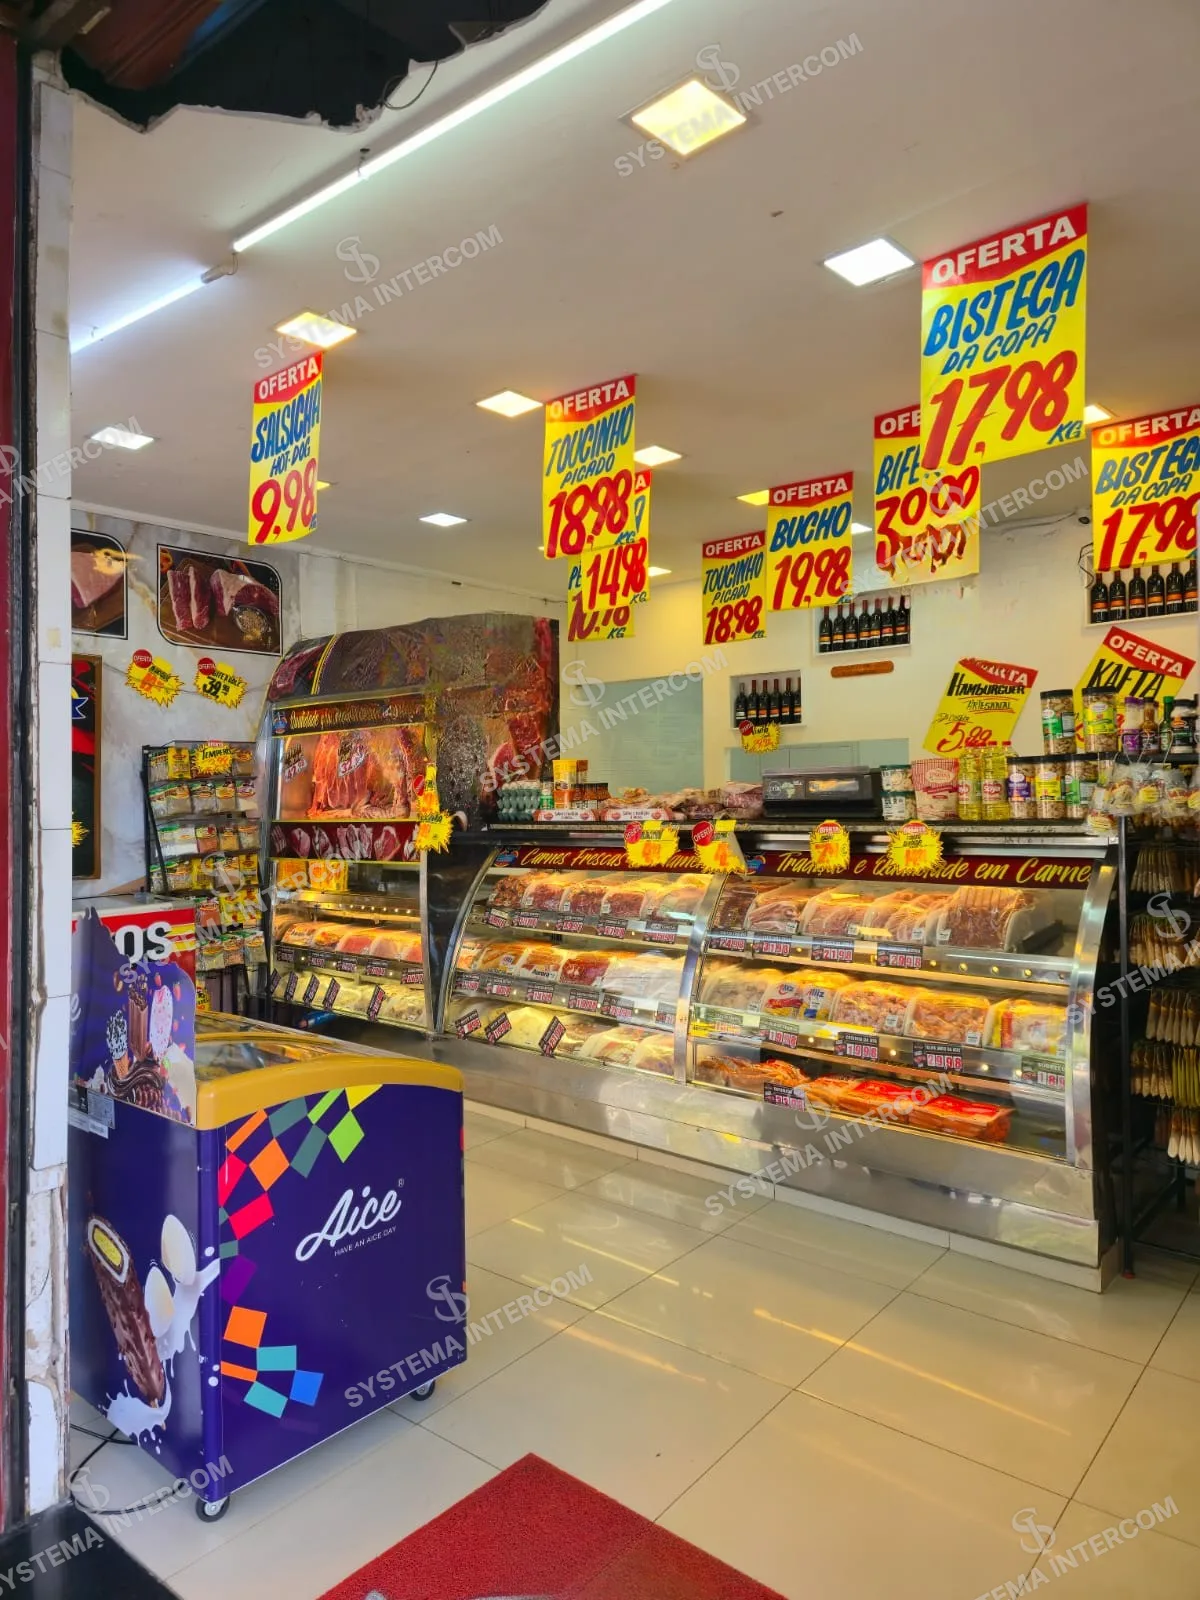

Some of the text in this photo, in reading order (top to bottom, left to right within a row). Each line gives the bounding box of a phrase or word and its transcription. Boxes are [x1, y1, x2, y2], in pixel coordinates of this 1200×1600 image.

[932, 216, 1077, 283] OFERTA
[923, 249, 1085, 356] BISTECA
[941, 315, 1056, 375] DA COPA
[258, 357, 319, 399] OFERTA
[550, 380, 630, 419] OFERTA
[250, 380, 321, 463] SALSICHA
[546, 402, 634, 477] TOUCINHO
[1047, 421, 1082, 444] KG
[560, 453, 616, 489] PICADO
[773, 477, 848, 504] OFERTA
[1111, 473, 1192, 508] DA COPA
[705, 535, 762, 557] OFERTA
[770, 501, 852, 553] BUCHO
[703, 552, 764, 595] TOUCINHO
[711, 583, 750, 606] PICADO
[1109, 635, 1185, 677] OFERTA
[1087, 659, 1165, 699] KAFTA
[693, 826, 714, 841] OFERTA
[521, 848, 564, 866] Carnes
[571, 849, 626, 868] Frescas
[854, 859, 867, 874] e
[974, 858, 1013, 881] em
[295, 1185, 401, 1261] Aice
[334, 1226, 397, 1257] HAVE AN AICE DAY
